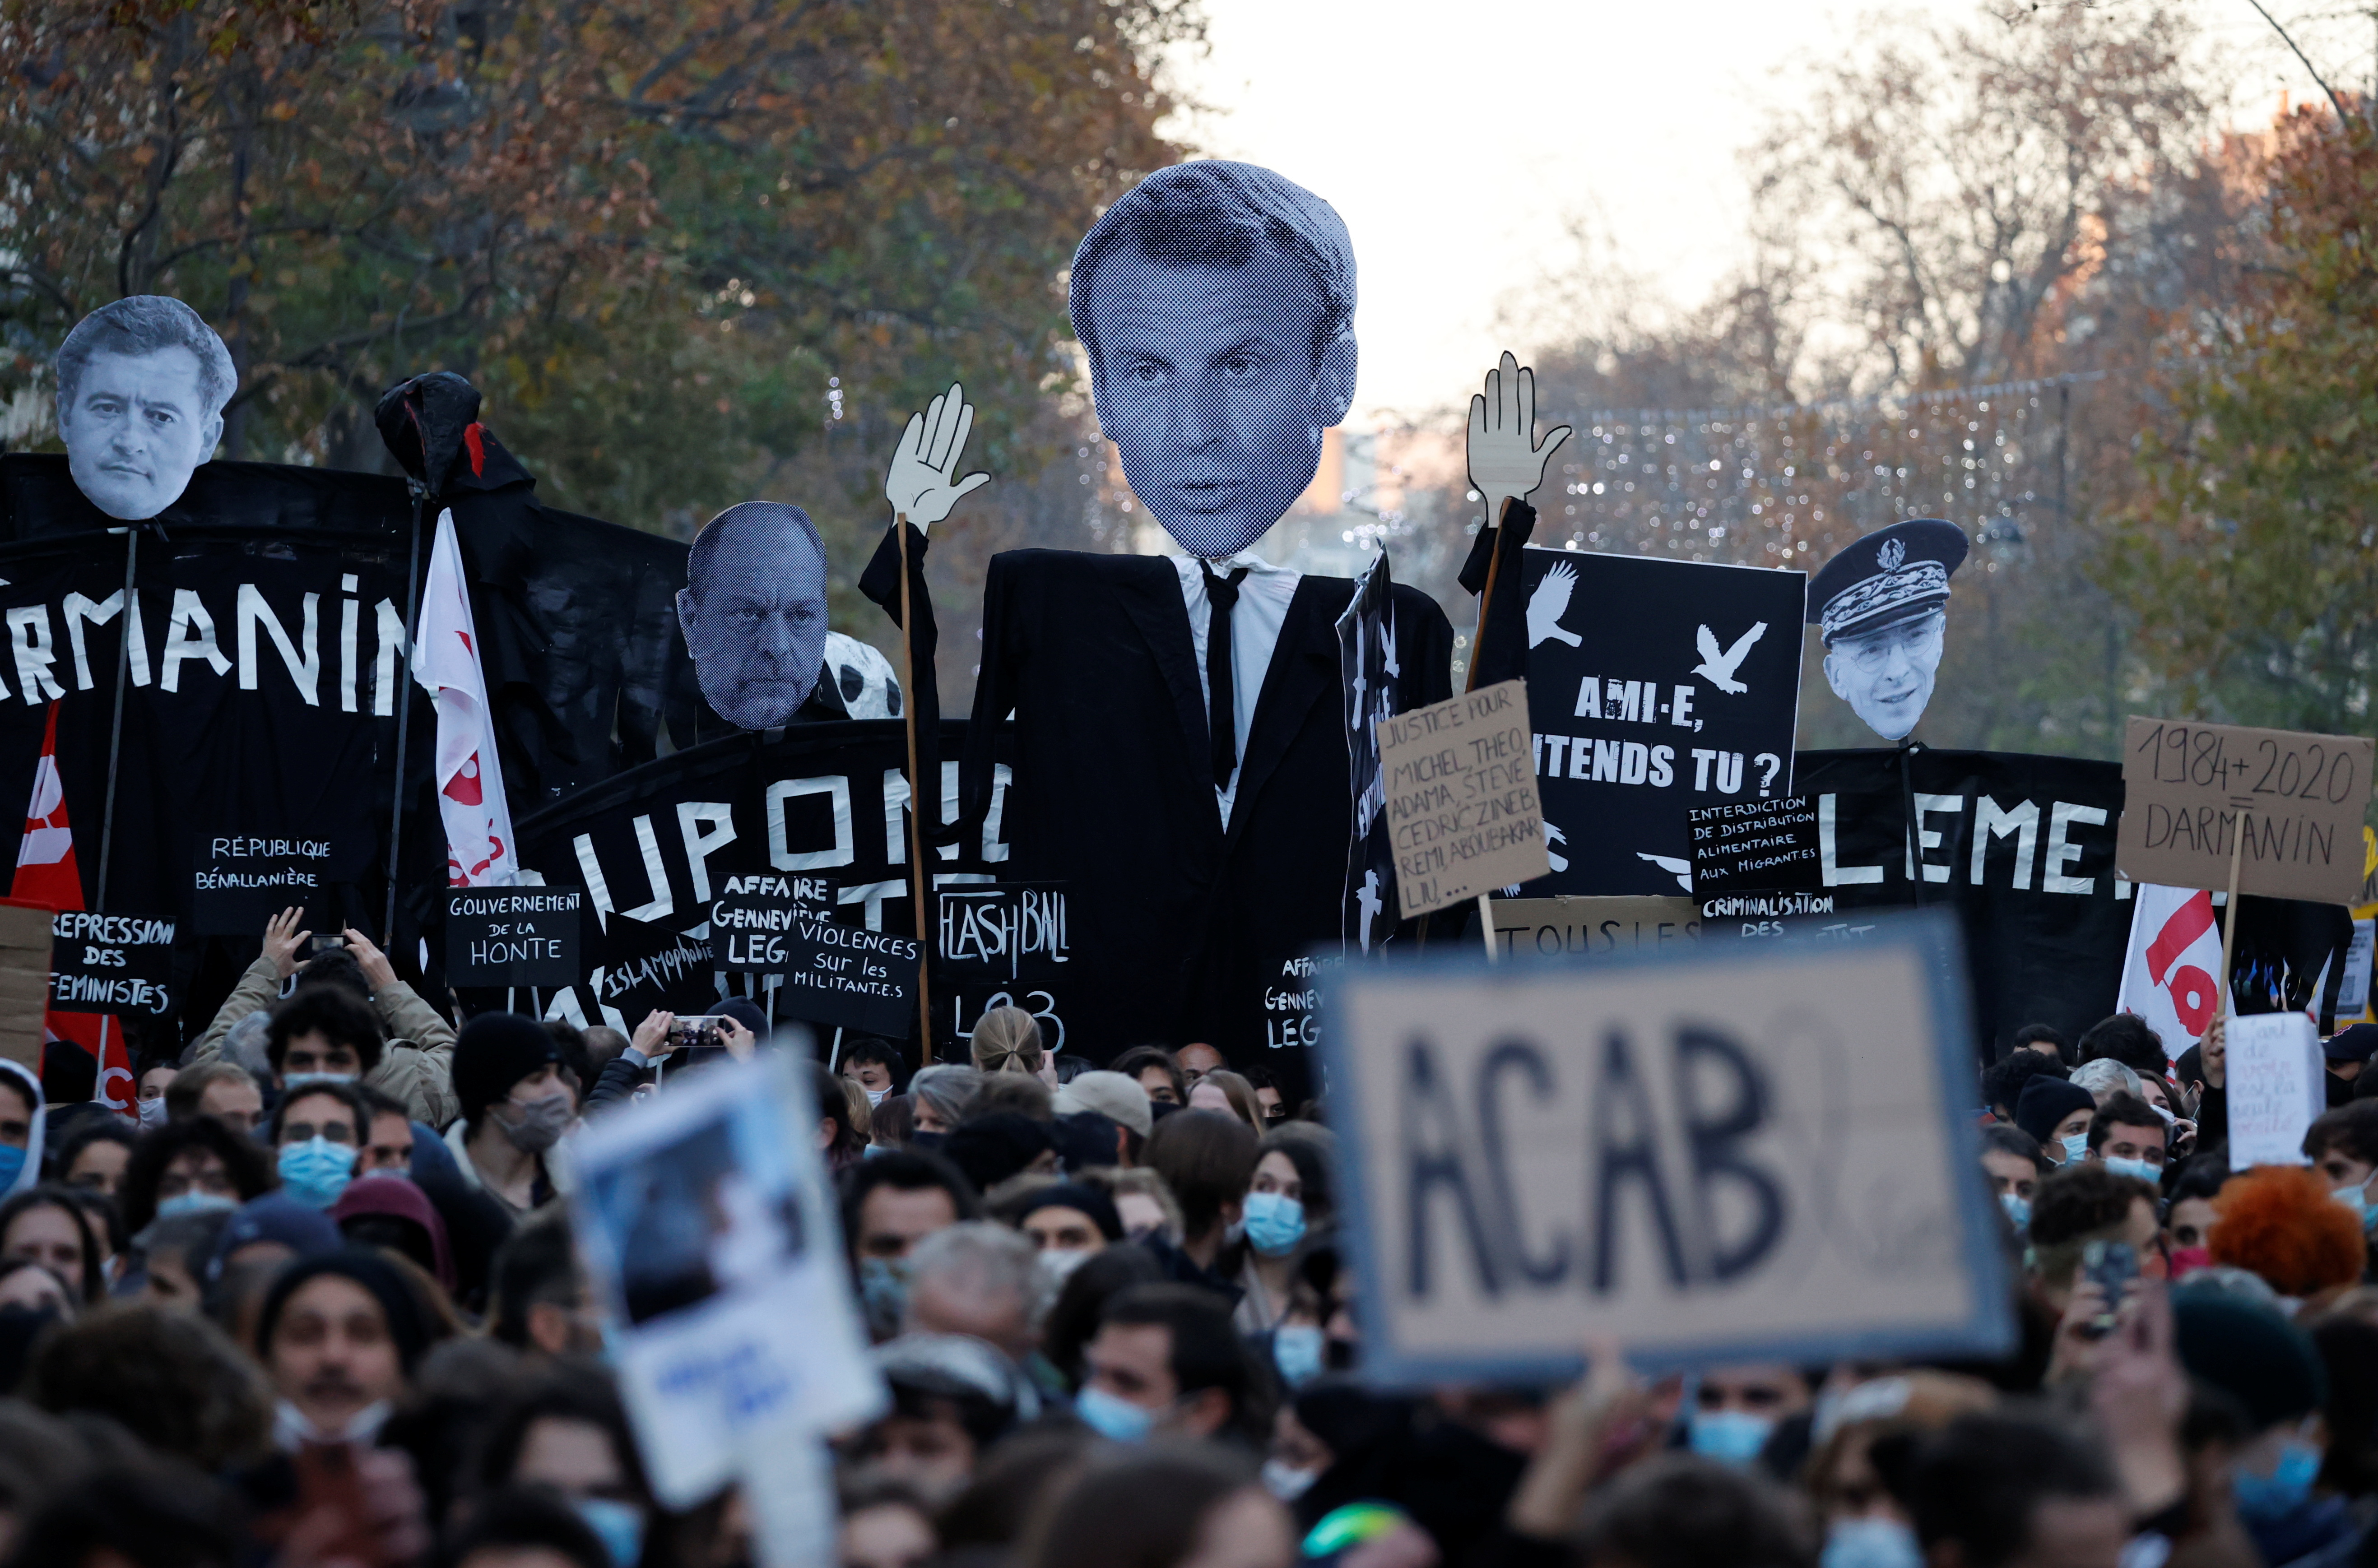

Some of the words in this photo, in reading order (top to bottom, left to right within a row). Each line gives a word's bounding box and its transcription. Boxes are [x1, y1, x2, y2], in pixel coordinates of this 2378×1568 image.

[1386, 703, 1463, 748] JUSTICE
[1468, 688, 1512, 720] POUR
[1691, 748, 1744, 794] TU
[1754, 753, 1780, 797] ?
[1694, 826, 1714, 840] DE
[724, 876, 827, 901] AFFAIRE
[450, 893, 580, 916] GOUVERNEMENT
[489, 924, 510, 937] DE
[517, 923, 534, 934] LA
[1742, 921, 1784, 937] DES
[83, 946, 126, 967] DES
[471, 938, 562, 965] HONTE
[729, 935, 789, 963] LEG
[863, 957, 887, 978] les
[1268, 1014, 1322, 1048] LEG
[1399, 1013, 1788, 1300] ACAB
